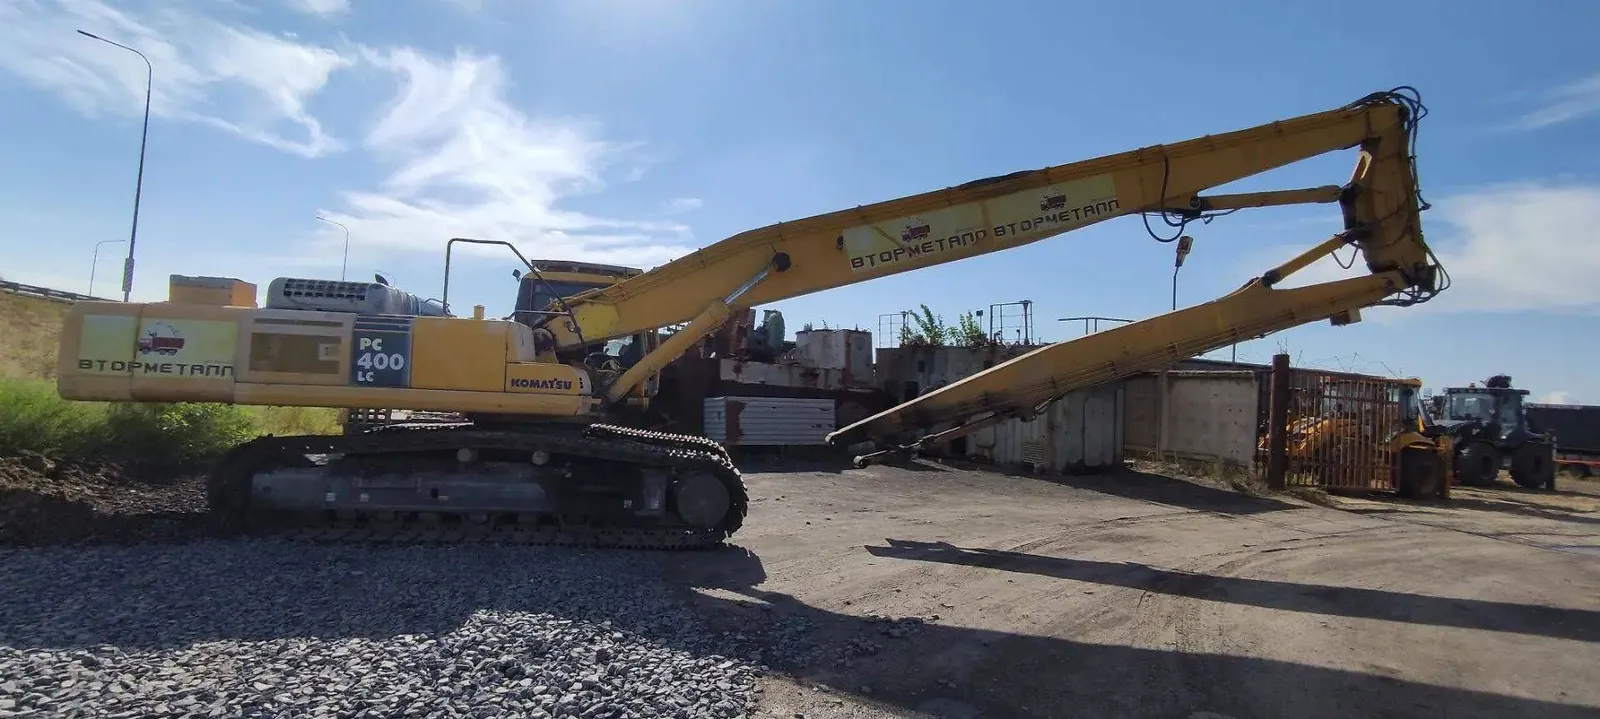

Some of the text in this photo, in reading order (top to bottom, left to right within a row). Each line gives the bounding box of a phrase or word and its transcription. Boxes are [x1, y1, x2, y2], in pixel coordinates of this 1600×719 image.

[359, 337, 383, 351] PC
[357, 352, 405, 371] 400
[357, 371, 375, 382] LC
[510, 377, 572, 390] KOMATSU
